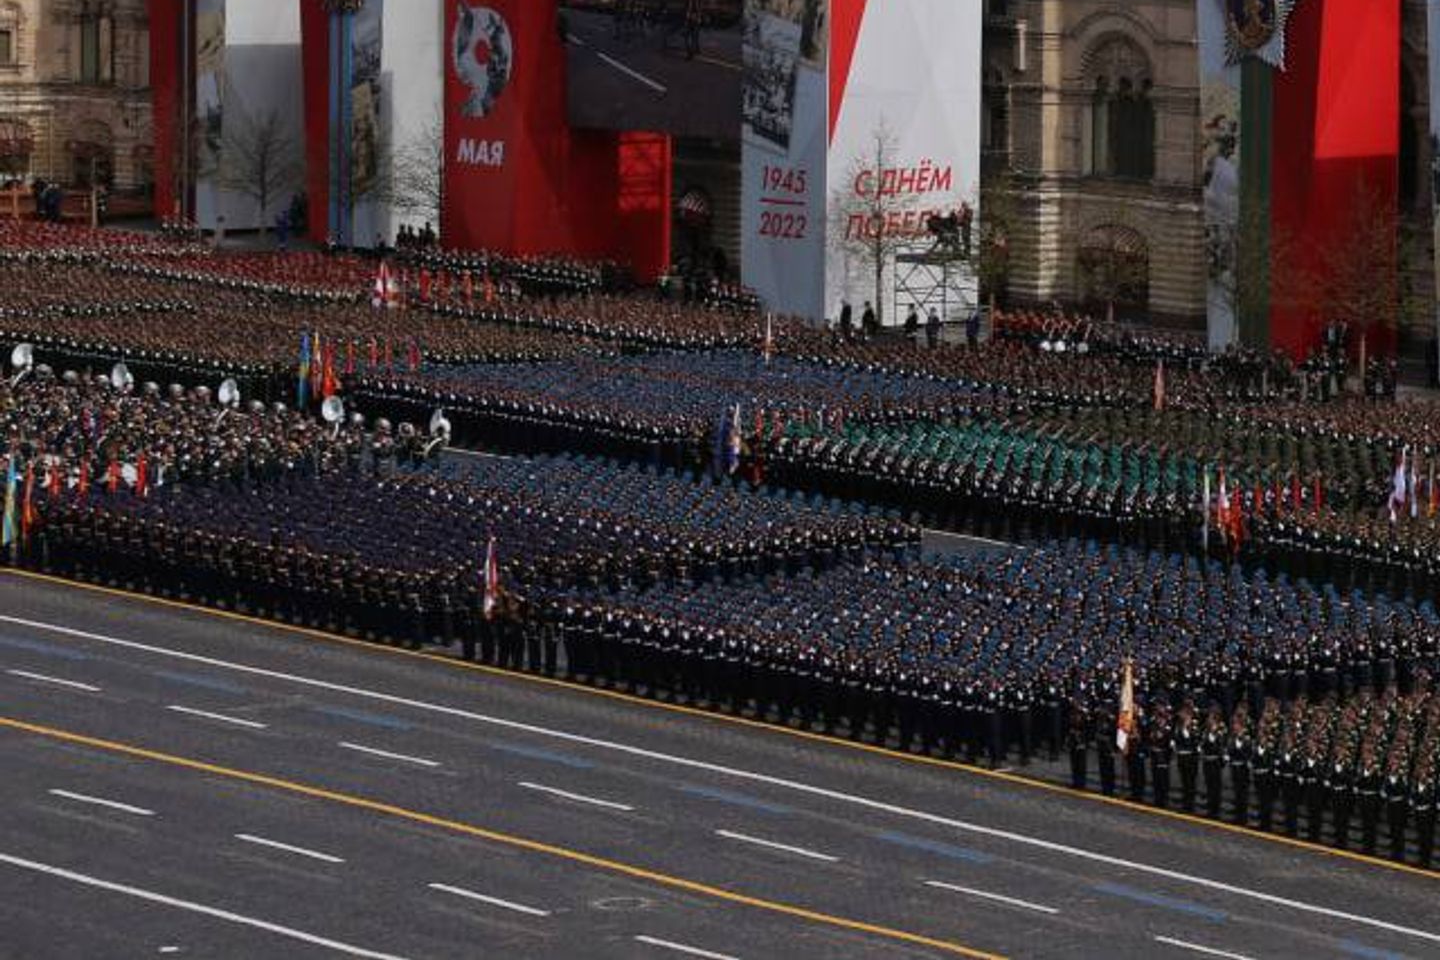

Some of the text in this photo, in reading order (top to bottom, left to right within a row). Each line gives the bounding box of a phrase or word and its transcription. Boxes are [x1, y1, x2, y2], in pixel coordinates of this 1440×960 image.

[454, 6, 513, 118] 9
[456, 139, 504, 166] МАЯ
[763, 166, 806, 194] 1945
[855, 158, 952, 200] С ДНЁМ
[759, 211, 807, 239] 2022
